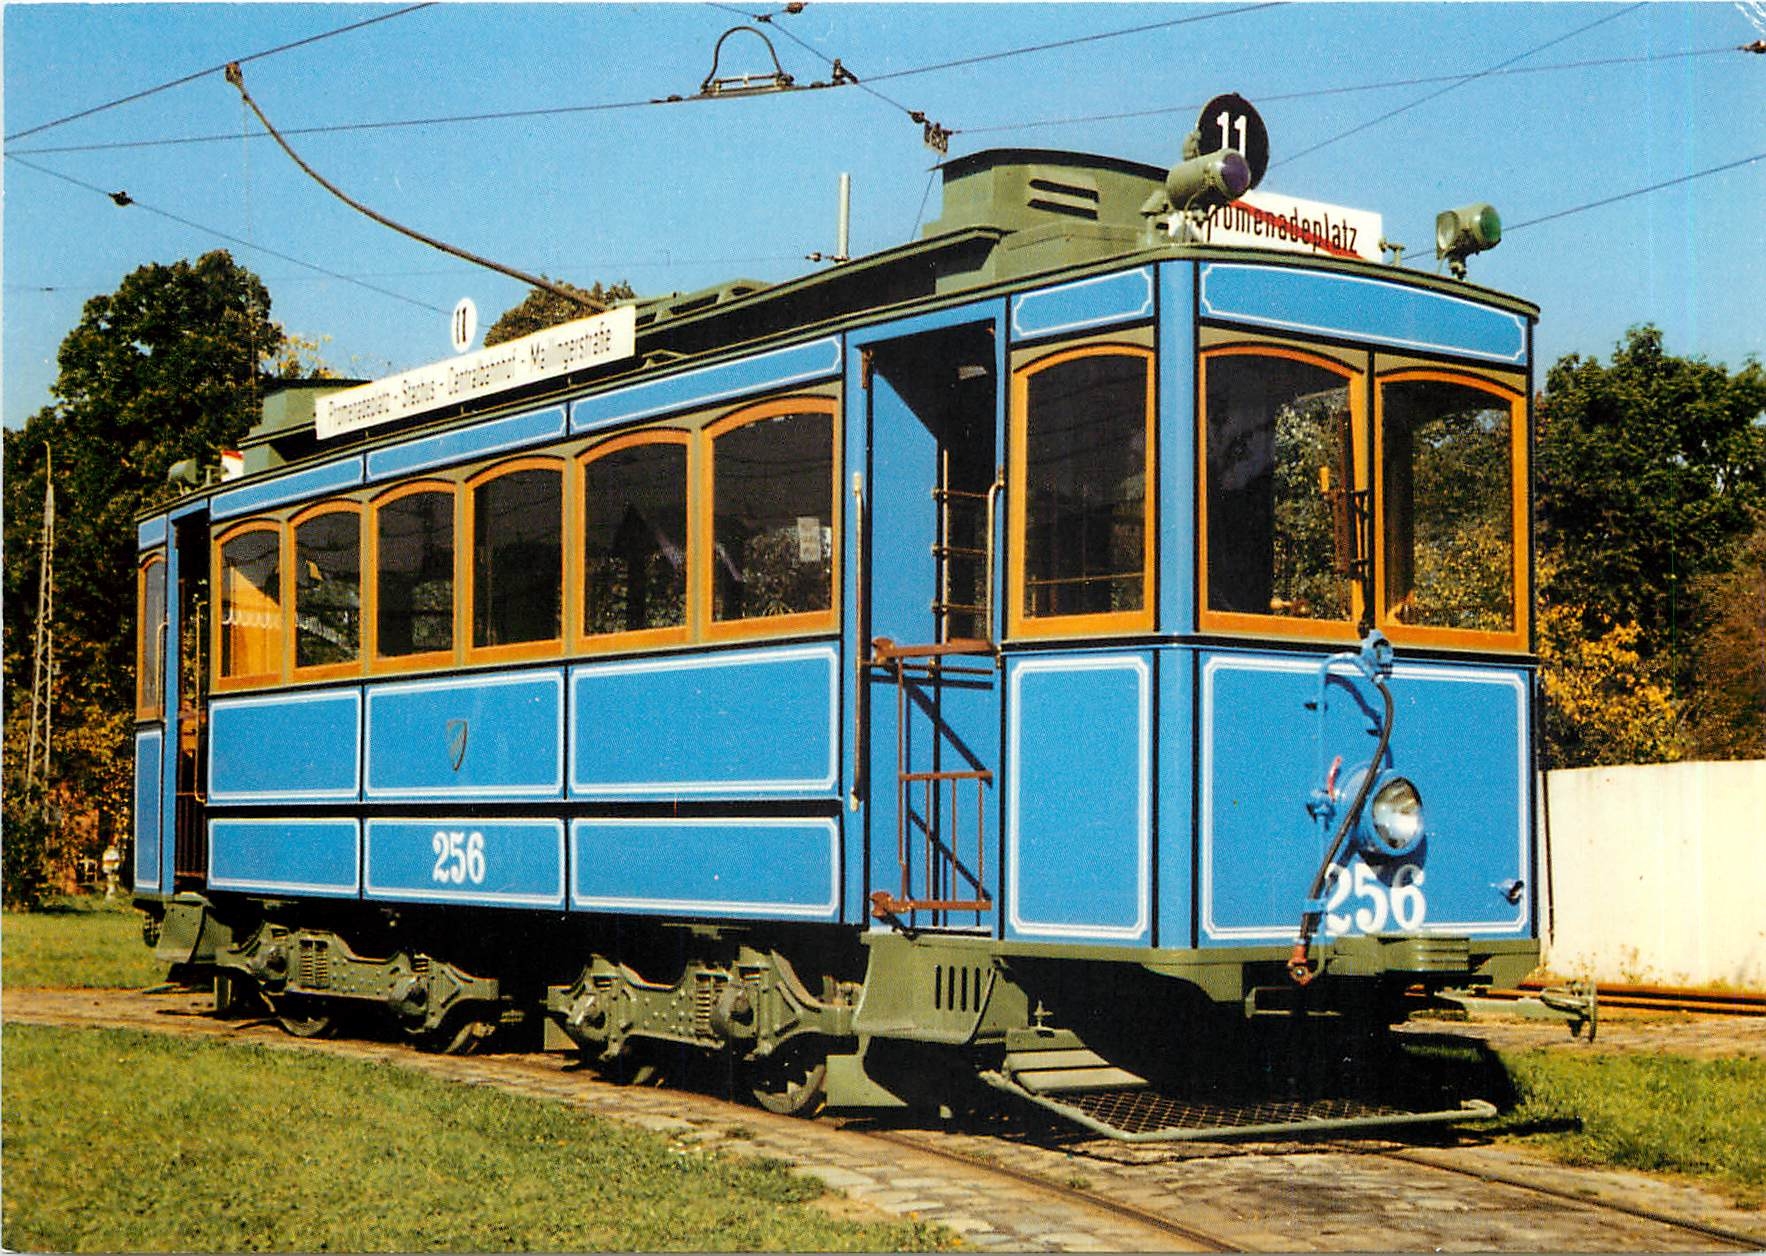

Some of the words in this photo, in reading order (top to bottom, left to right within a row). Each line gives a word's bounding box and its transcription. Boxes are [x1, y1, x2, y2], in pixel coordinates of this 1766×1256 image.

[1216, 111, 1246, 158] 11
[432, 831, 486, 885] 256
[1325, 862, 1427, 934] 256
